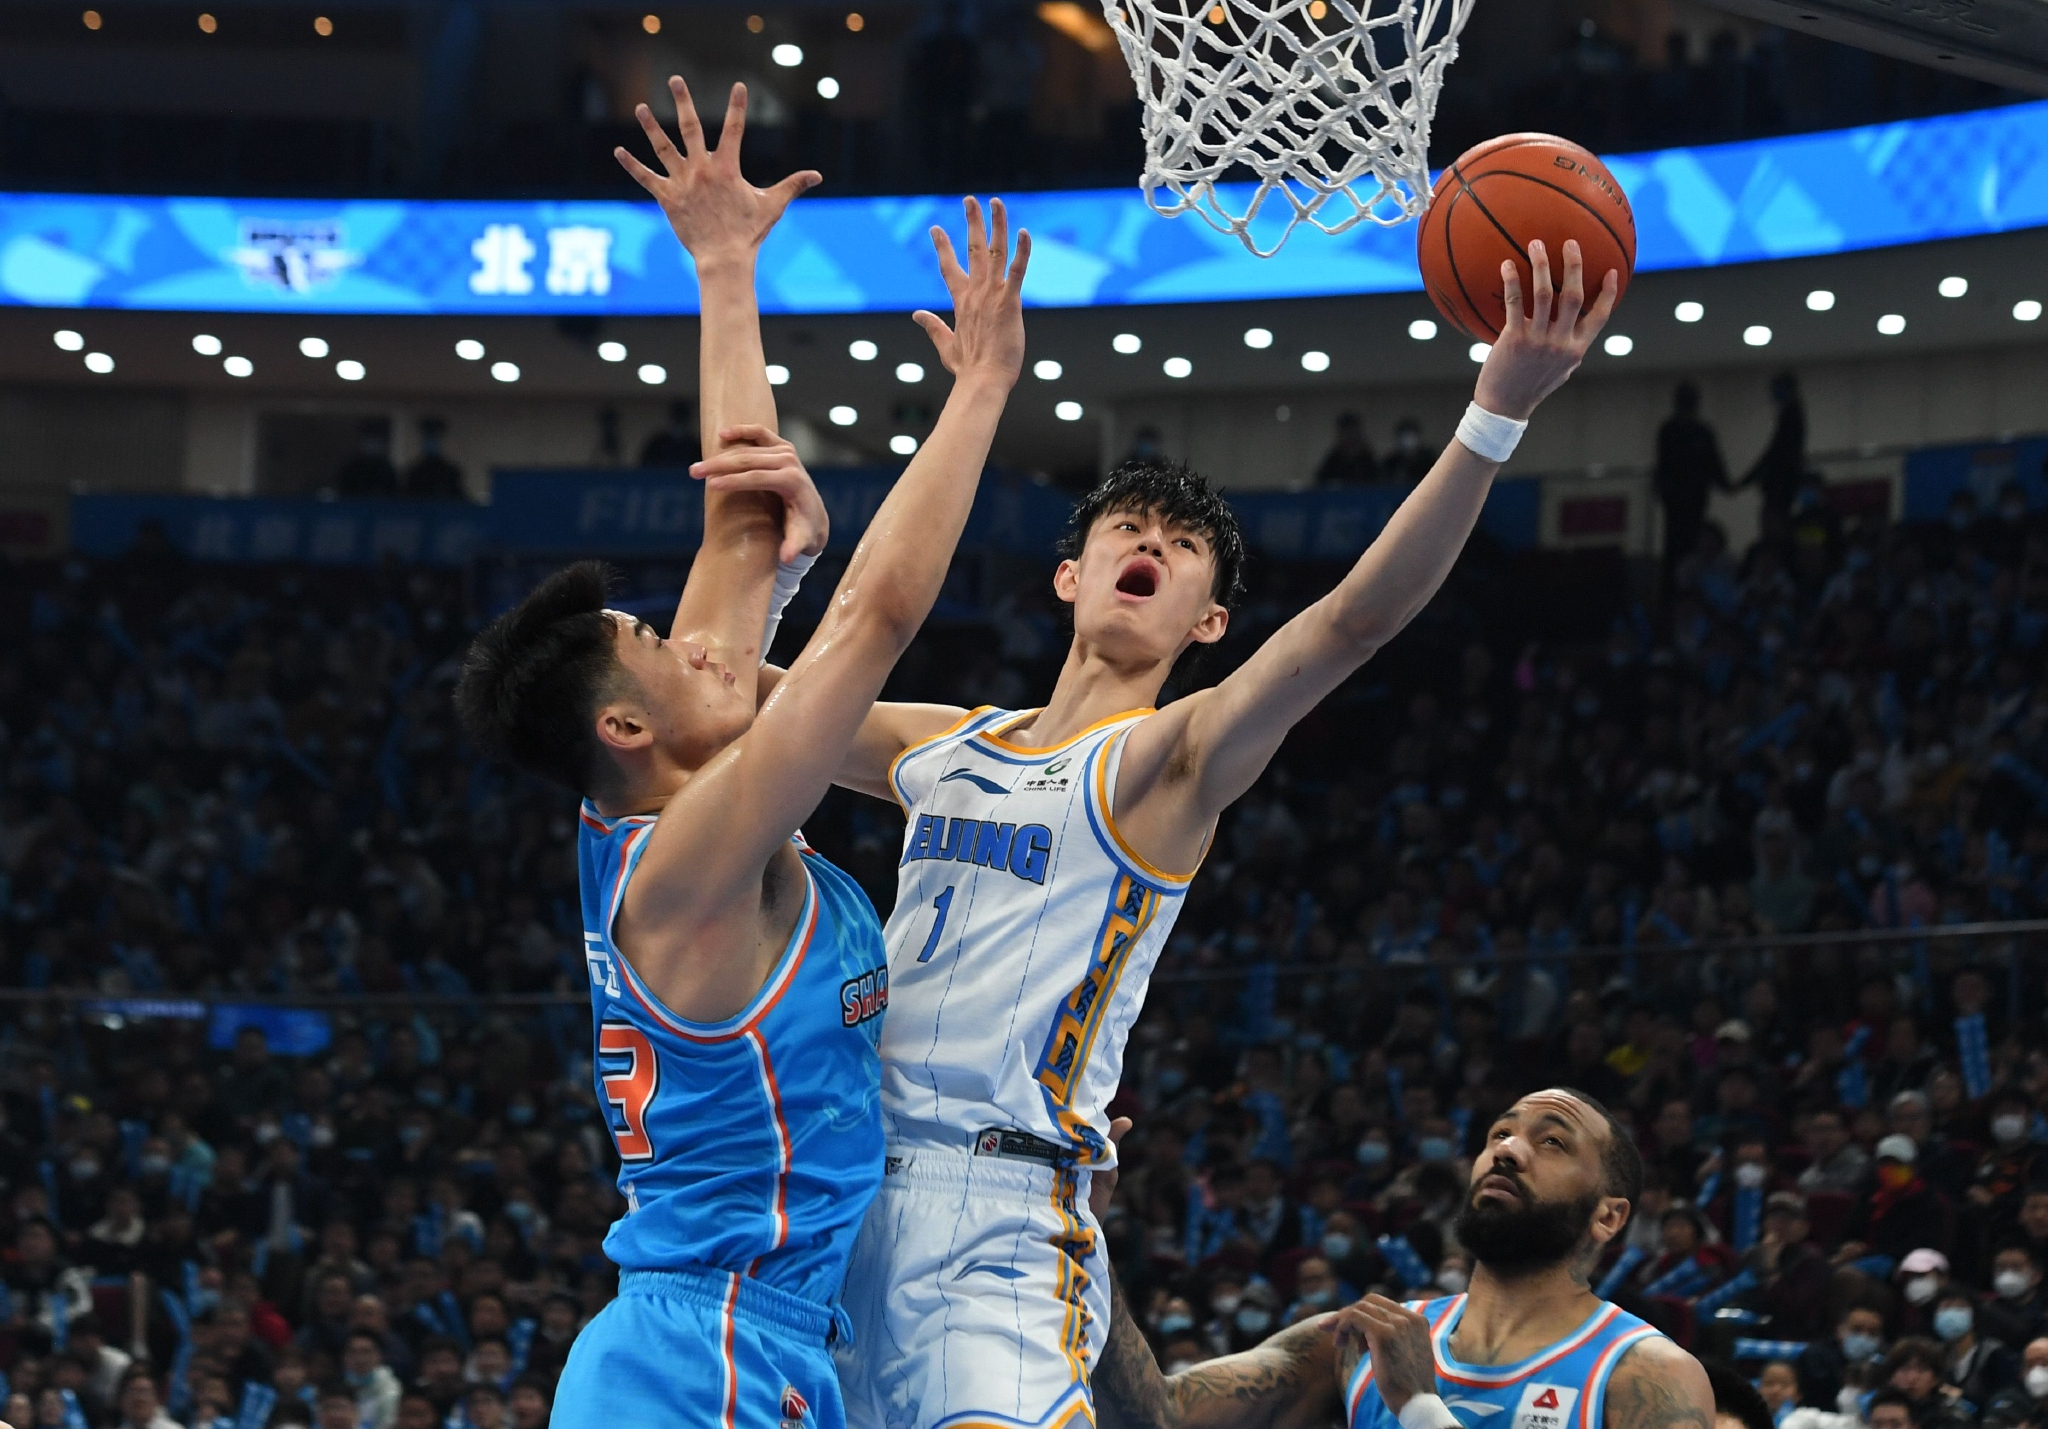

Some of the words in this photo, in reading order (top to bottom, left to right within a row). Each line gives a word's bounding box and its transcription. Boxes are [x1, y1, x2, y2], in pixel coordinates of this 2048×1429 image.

[469, 223, 612, 296] 北京
[1026, 778, 1069, 787] 中国人寿
[917, 885, 955, 963] 1
